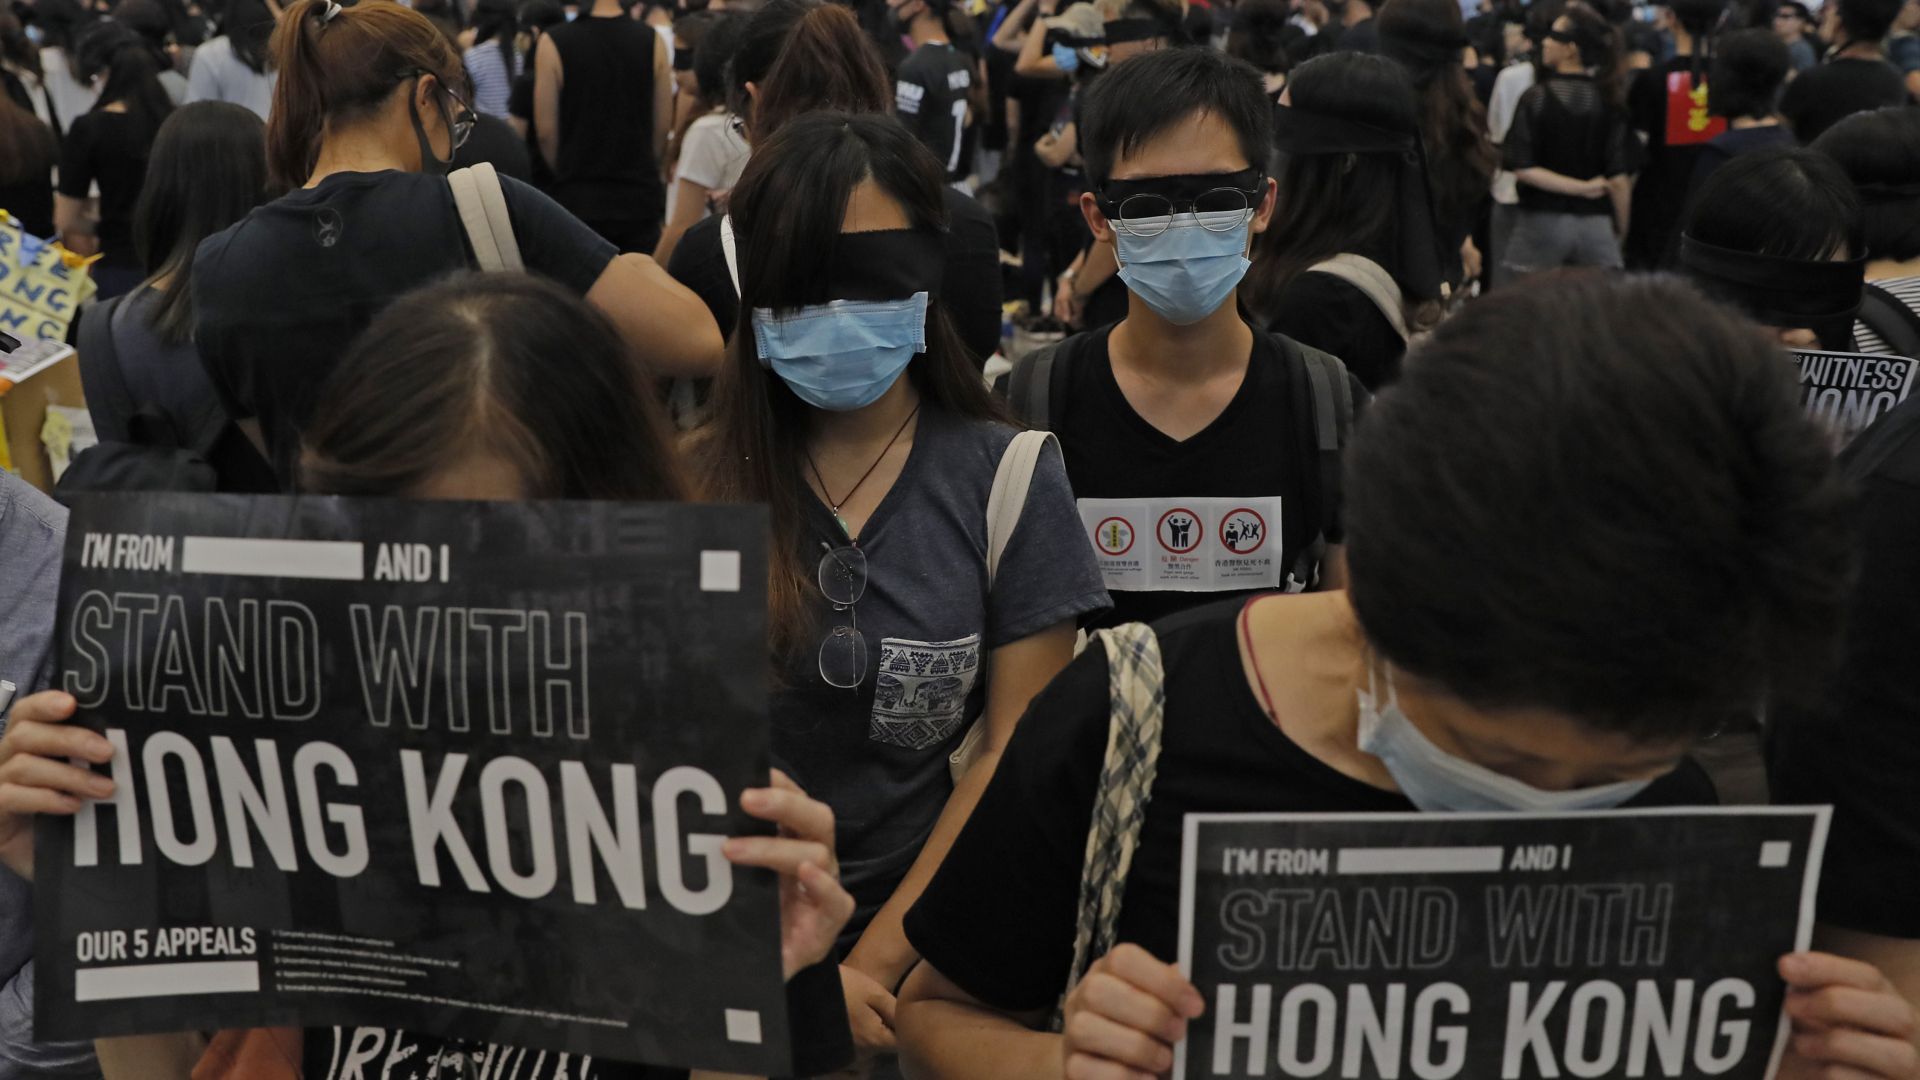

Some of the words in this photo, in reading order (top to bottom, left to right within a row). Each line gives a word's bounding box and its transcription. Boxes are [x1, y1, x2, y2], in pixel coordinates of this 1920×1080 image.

[1799, 355, 1906, 390] WITNESS
[81, 532, 112, 568] I'M
[113, 533, 174, 572] FROM
[374, 542, 431, 582] AND
[440, 544, 449, 582] I
[63, 589, 321, 721] STAND
[349, 604, 590, 740] WITH
[73, 728, 369, 878] HONG
[400, 749, 734, 915] KONG
[1222, 847, 1258, 875] I'M
[1263, 848, 1329, 875] FROM
[1509, 844, 1557, 871] AND
[1561, 844, 1572, 870] I
[76, 930, 127, 961] OUR
[133, 928, 149, 958] 5
[154, 927, 257, 957] APPEALS
[1216, 885, 1459, 972] STAND
[1485, 882, 1674, 968] WITH
[1212, 981, 1471, 1080] HONG
[1501, 977, 1756, 1080] KONG
